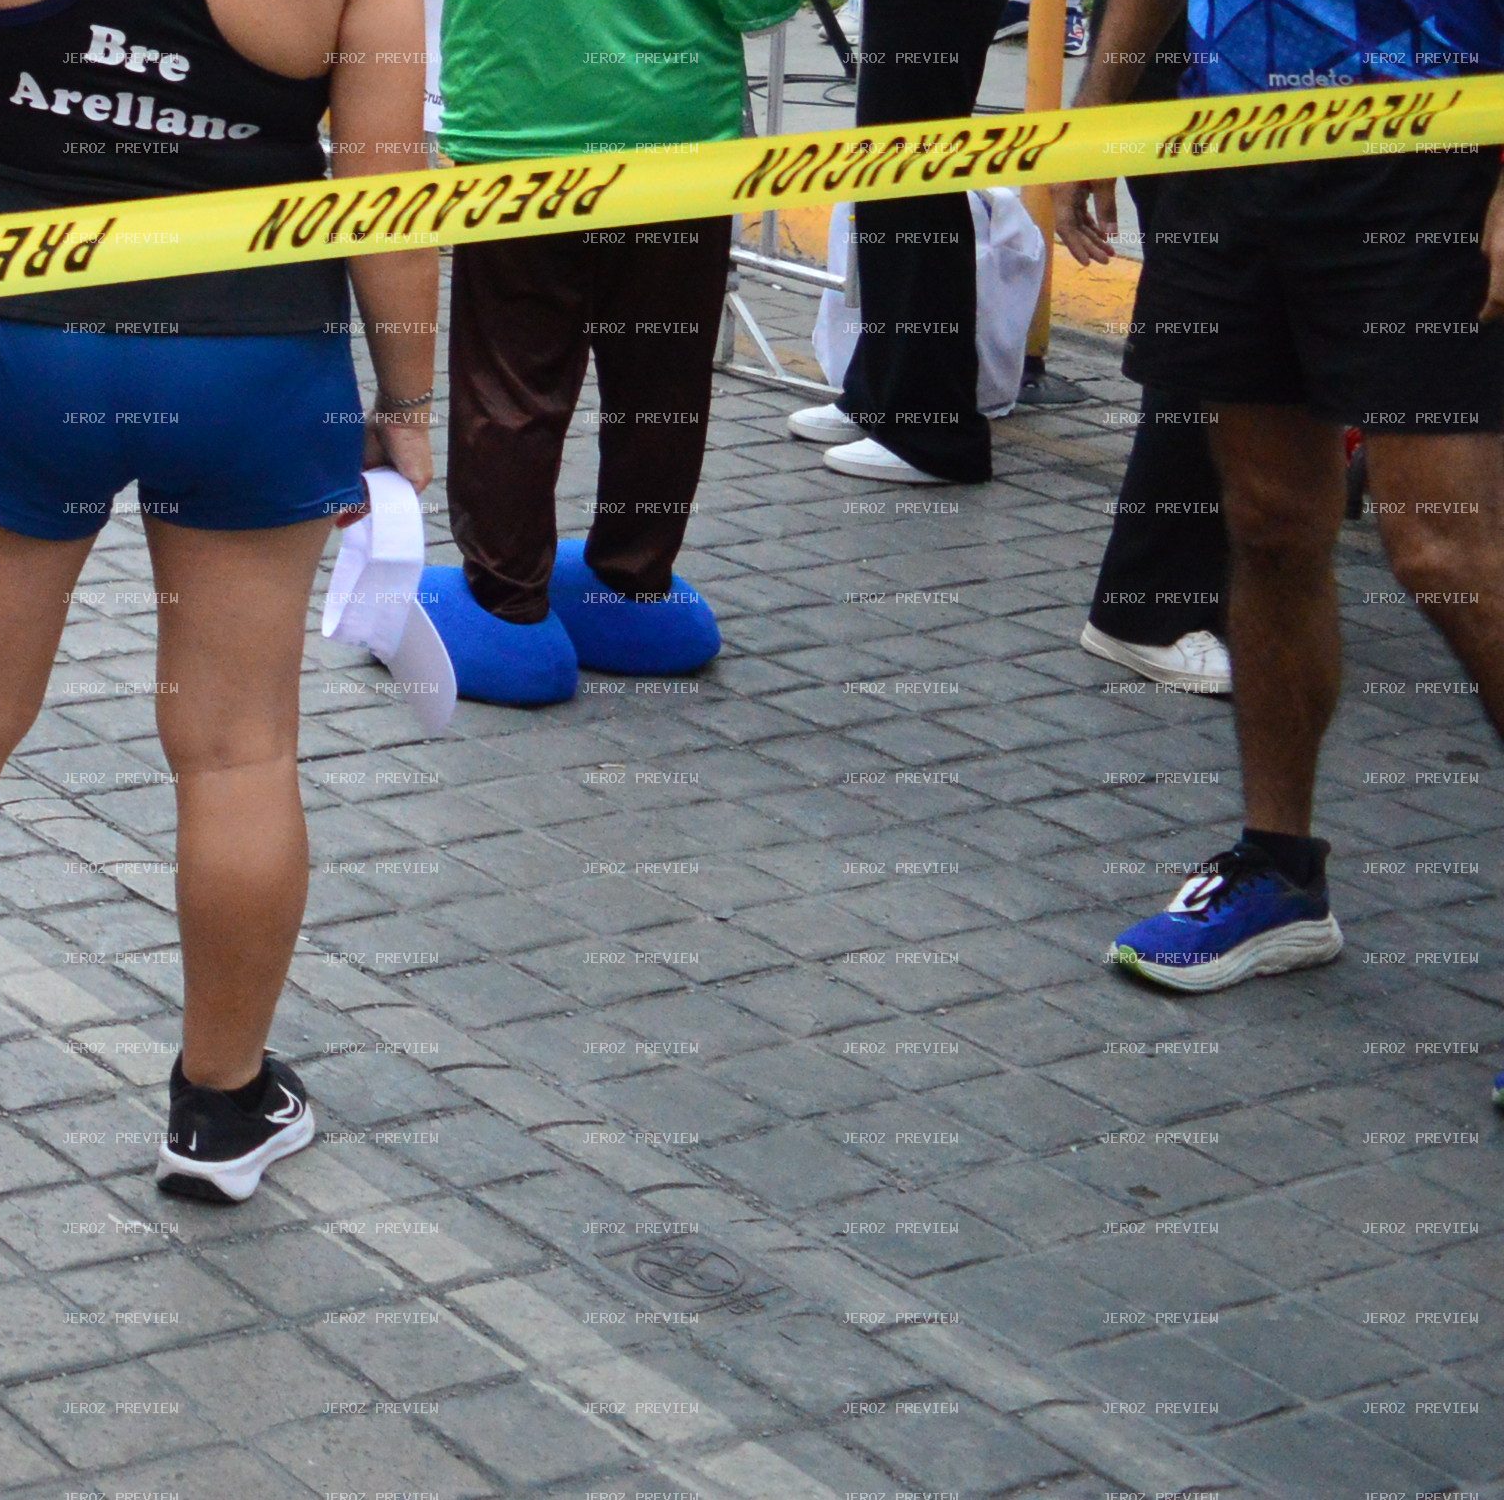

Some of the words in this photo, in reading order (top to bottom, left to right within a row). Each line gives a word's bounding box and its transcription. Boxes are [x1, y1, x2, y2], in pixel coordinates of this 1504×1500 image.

[85, 24, 191, 82] Bre
[1268, 68, 1353, 87] madeto
[9, 71, 261, 140] Arellano
[732, 122, 1071, 200] PRECAUCION
[247, 163, 627, 252] PRECAUCION
